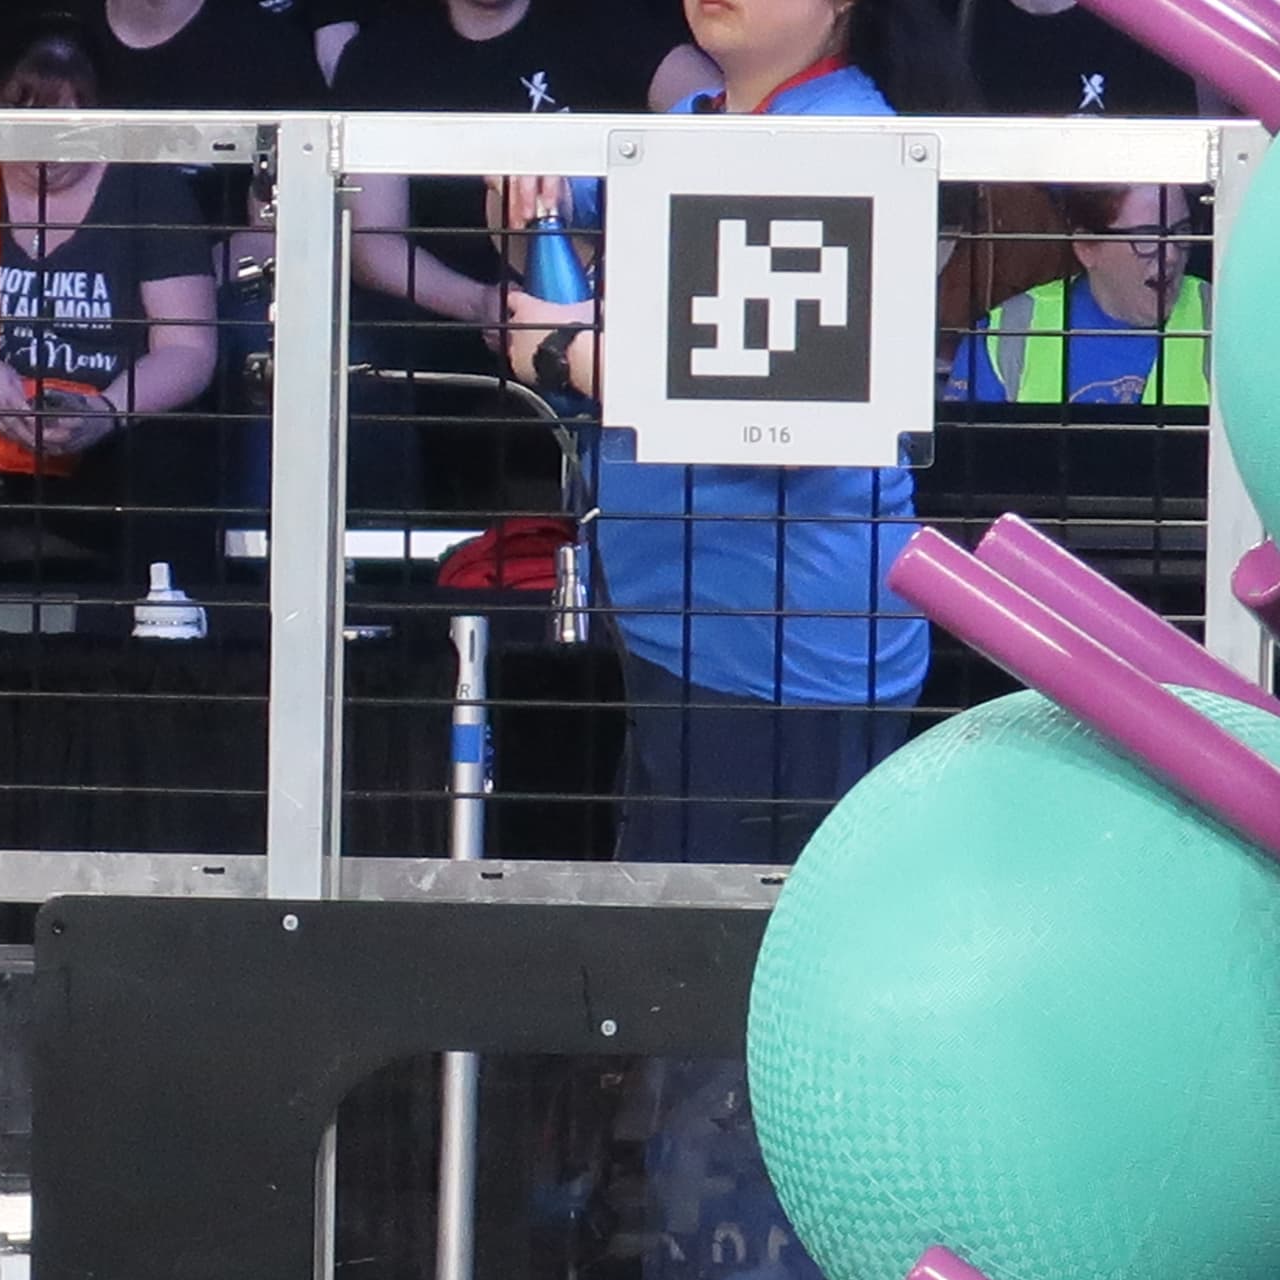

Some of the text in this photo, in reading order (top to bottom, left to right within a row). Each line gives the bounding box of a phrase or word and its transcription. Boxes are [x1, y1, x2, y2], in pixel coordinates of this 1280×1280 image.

[44, 271, 87, 299] LIKE
[92, 273, 108, 299] A
[55, 301, 112, 328] MOM
[743, 426, 791, 443] ID 16
